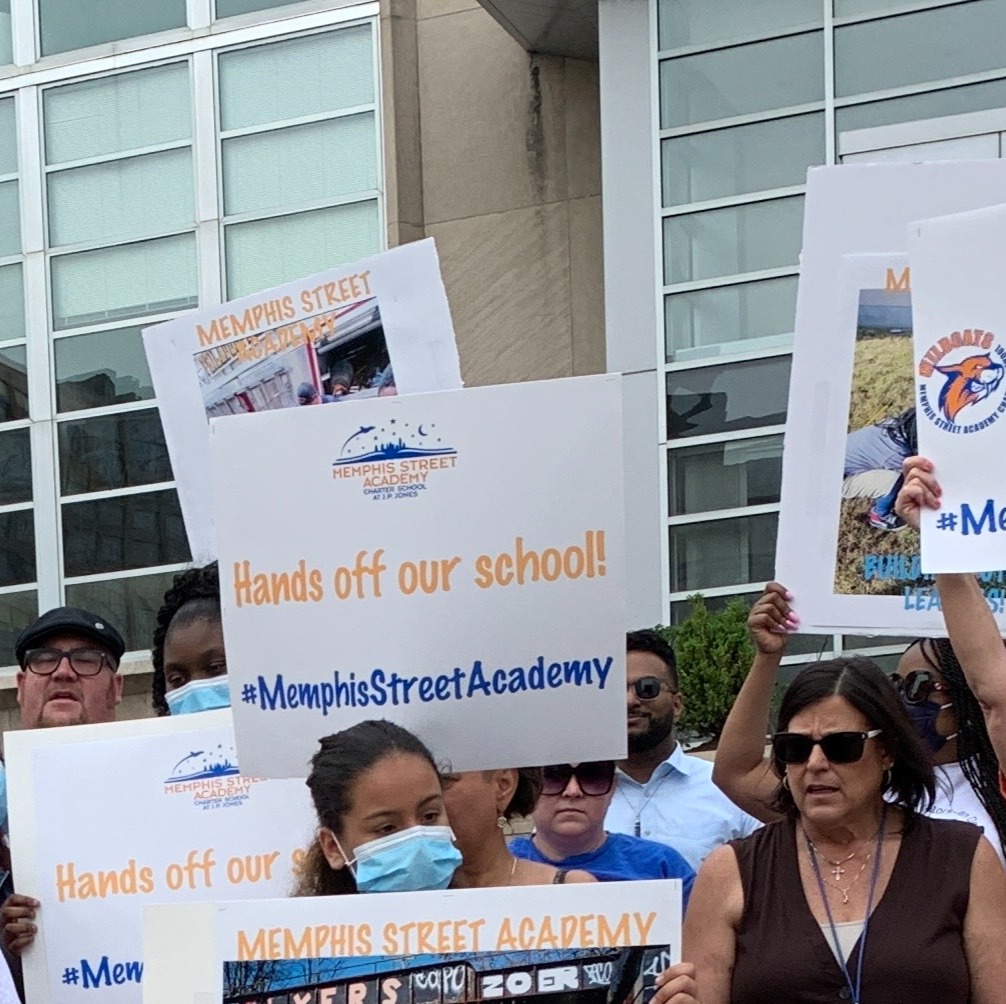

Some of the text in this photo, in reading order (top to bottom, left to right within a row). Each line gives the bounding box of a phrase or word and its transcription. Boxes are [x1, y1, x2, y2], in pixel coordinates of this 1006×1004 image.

[196, 270, 371, 347] MEMPHIS STREET
[333, 456, 457, 479] MEMPHIS STREET
[363, 472, 428, 488] ACADEMY
[234, 530, 607, 607] Hands off our school!
[241, 657, 613, 715] #MemphisStreetAcademy
[164, 779, 222, 794] MEMPHIS
[194, 785, 250, 800] ACADEMY
[56, 859, 154, 903] Hands
[166, 848, 216, 890] off
[227, 851, 280, 884] our
[237, 912, 657, 960] MEMPHIS STREET ACADEMY
